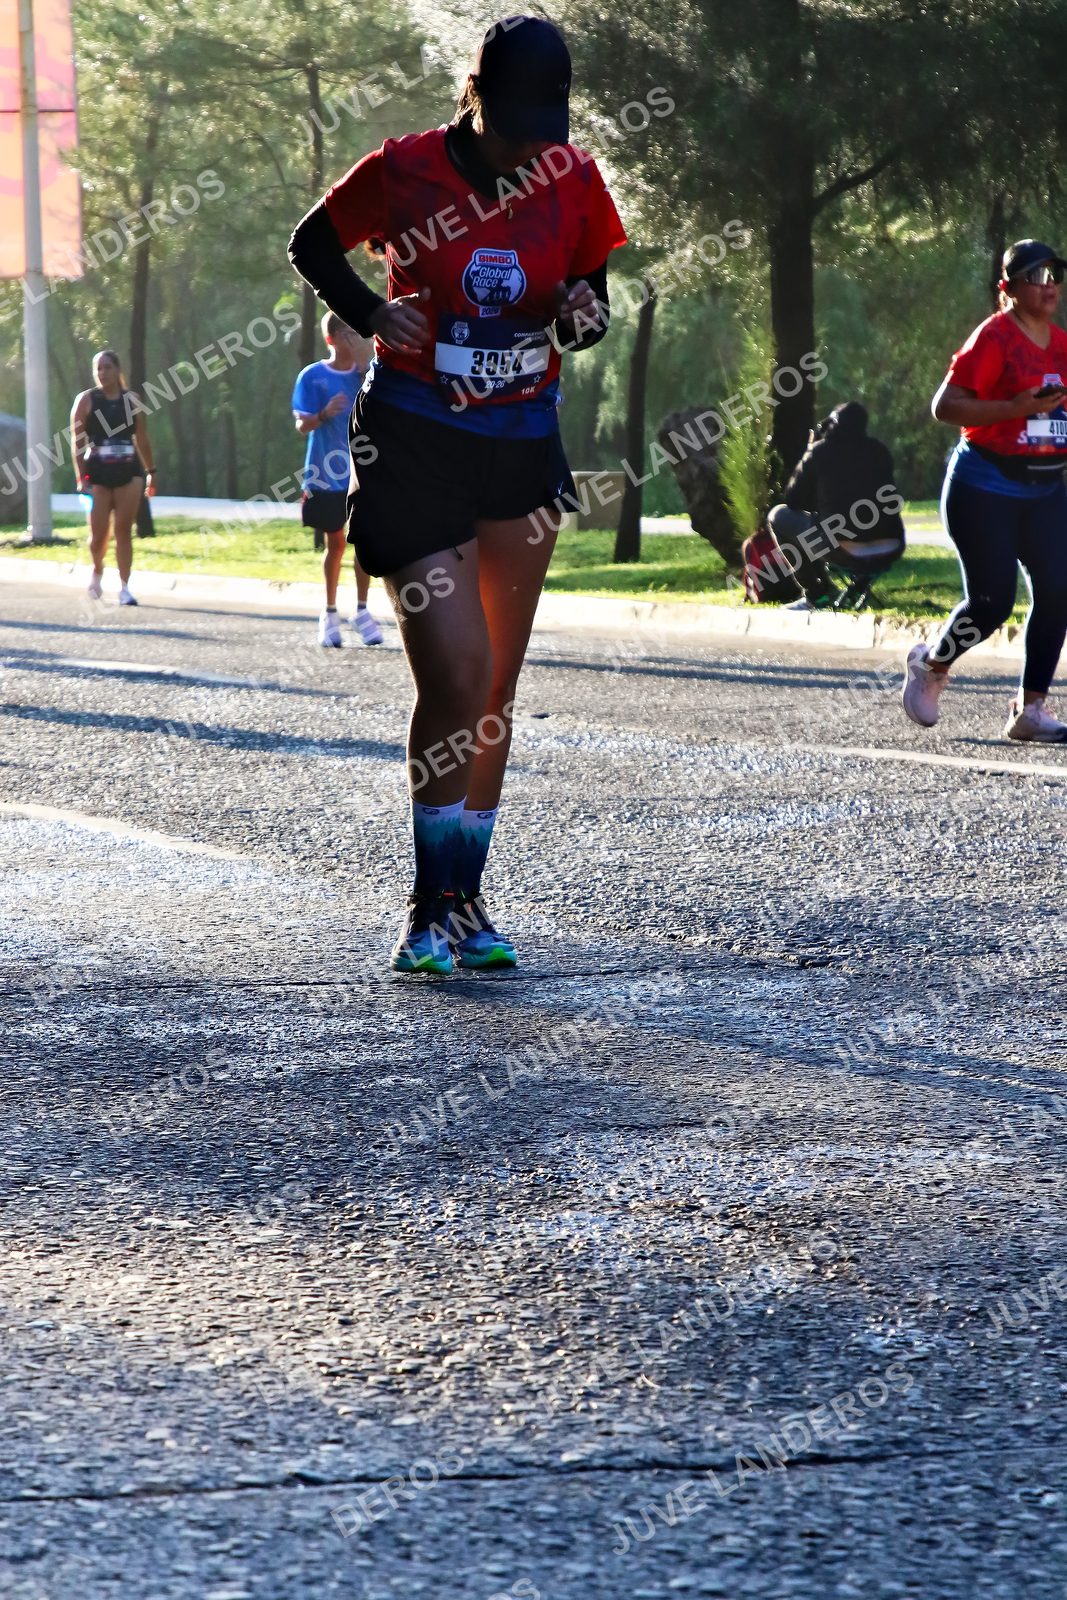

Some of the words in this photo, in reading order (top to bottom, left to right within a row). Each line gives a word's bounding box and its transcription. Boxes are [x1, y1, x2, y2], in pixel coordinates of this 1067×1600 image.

[479, 255, 512, 264] BIMBO
[479, 266, 512, 280] Global
[472, 276, 498, 287] Race
[471, 350, 524, 375] 3954
[521, 385, 536, 395] 10K
